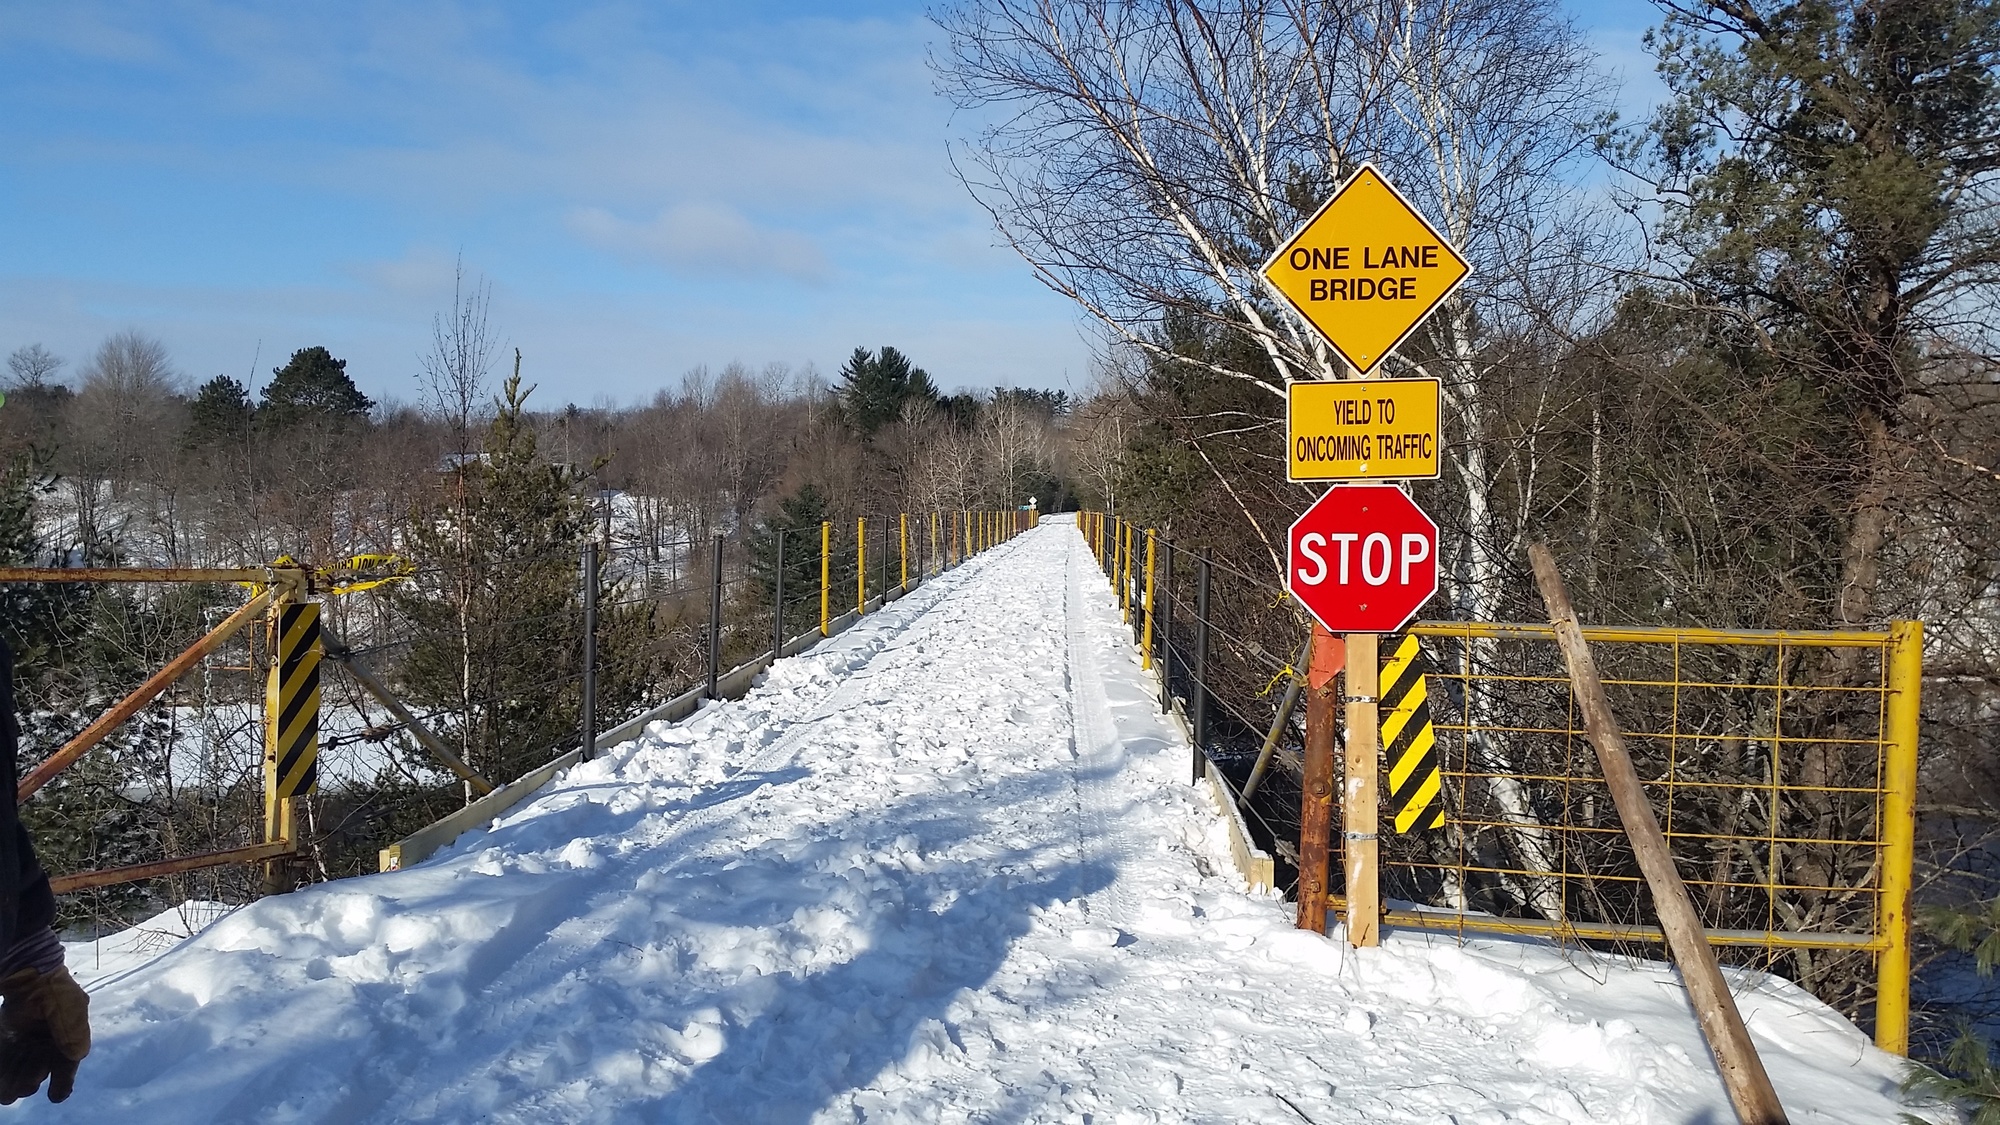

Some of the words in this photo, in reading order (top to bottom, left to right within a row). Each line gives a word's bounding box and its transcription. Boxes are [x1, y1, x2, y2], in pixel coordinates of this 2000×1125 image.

[1289, 247, 1350, 271] ONE
[1363, 245, 1439, 269] LANE
[1310, 277, 1417, 302] BRIDGE
[1333, 399, 1372, 426] YIELD
[1376, 398, 1395, 425] TO
[1296, 434, 1371, 463] ONCOMING
[1376, 432, 1432, 460] TRAFFIC
[1297, 532, 1430, 586] STOP
